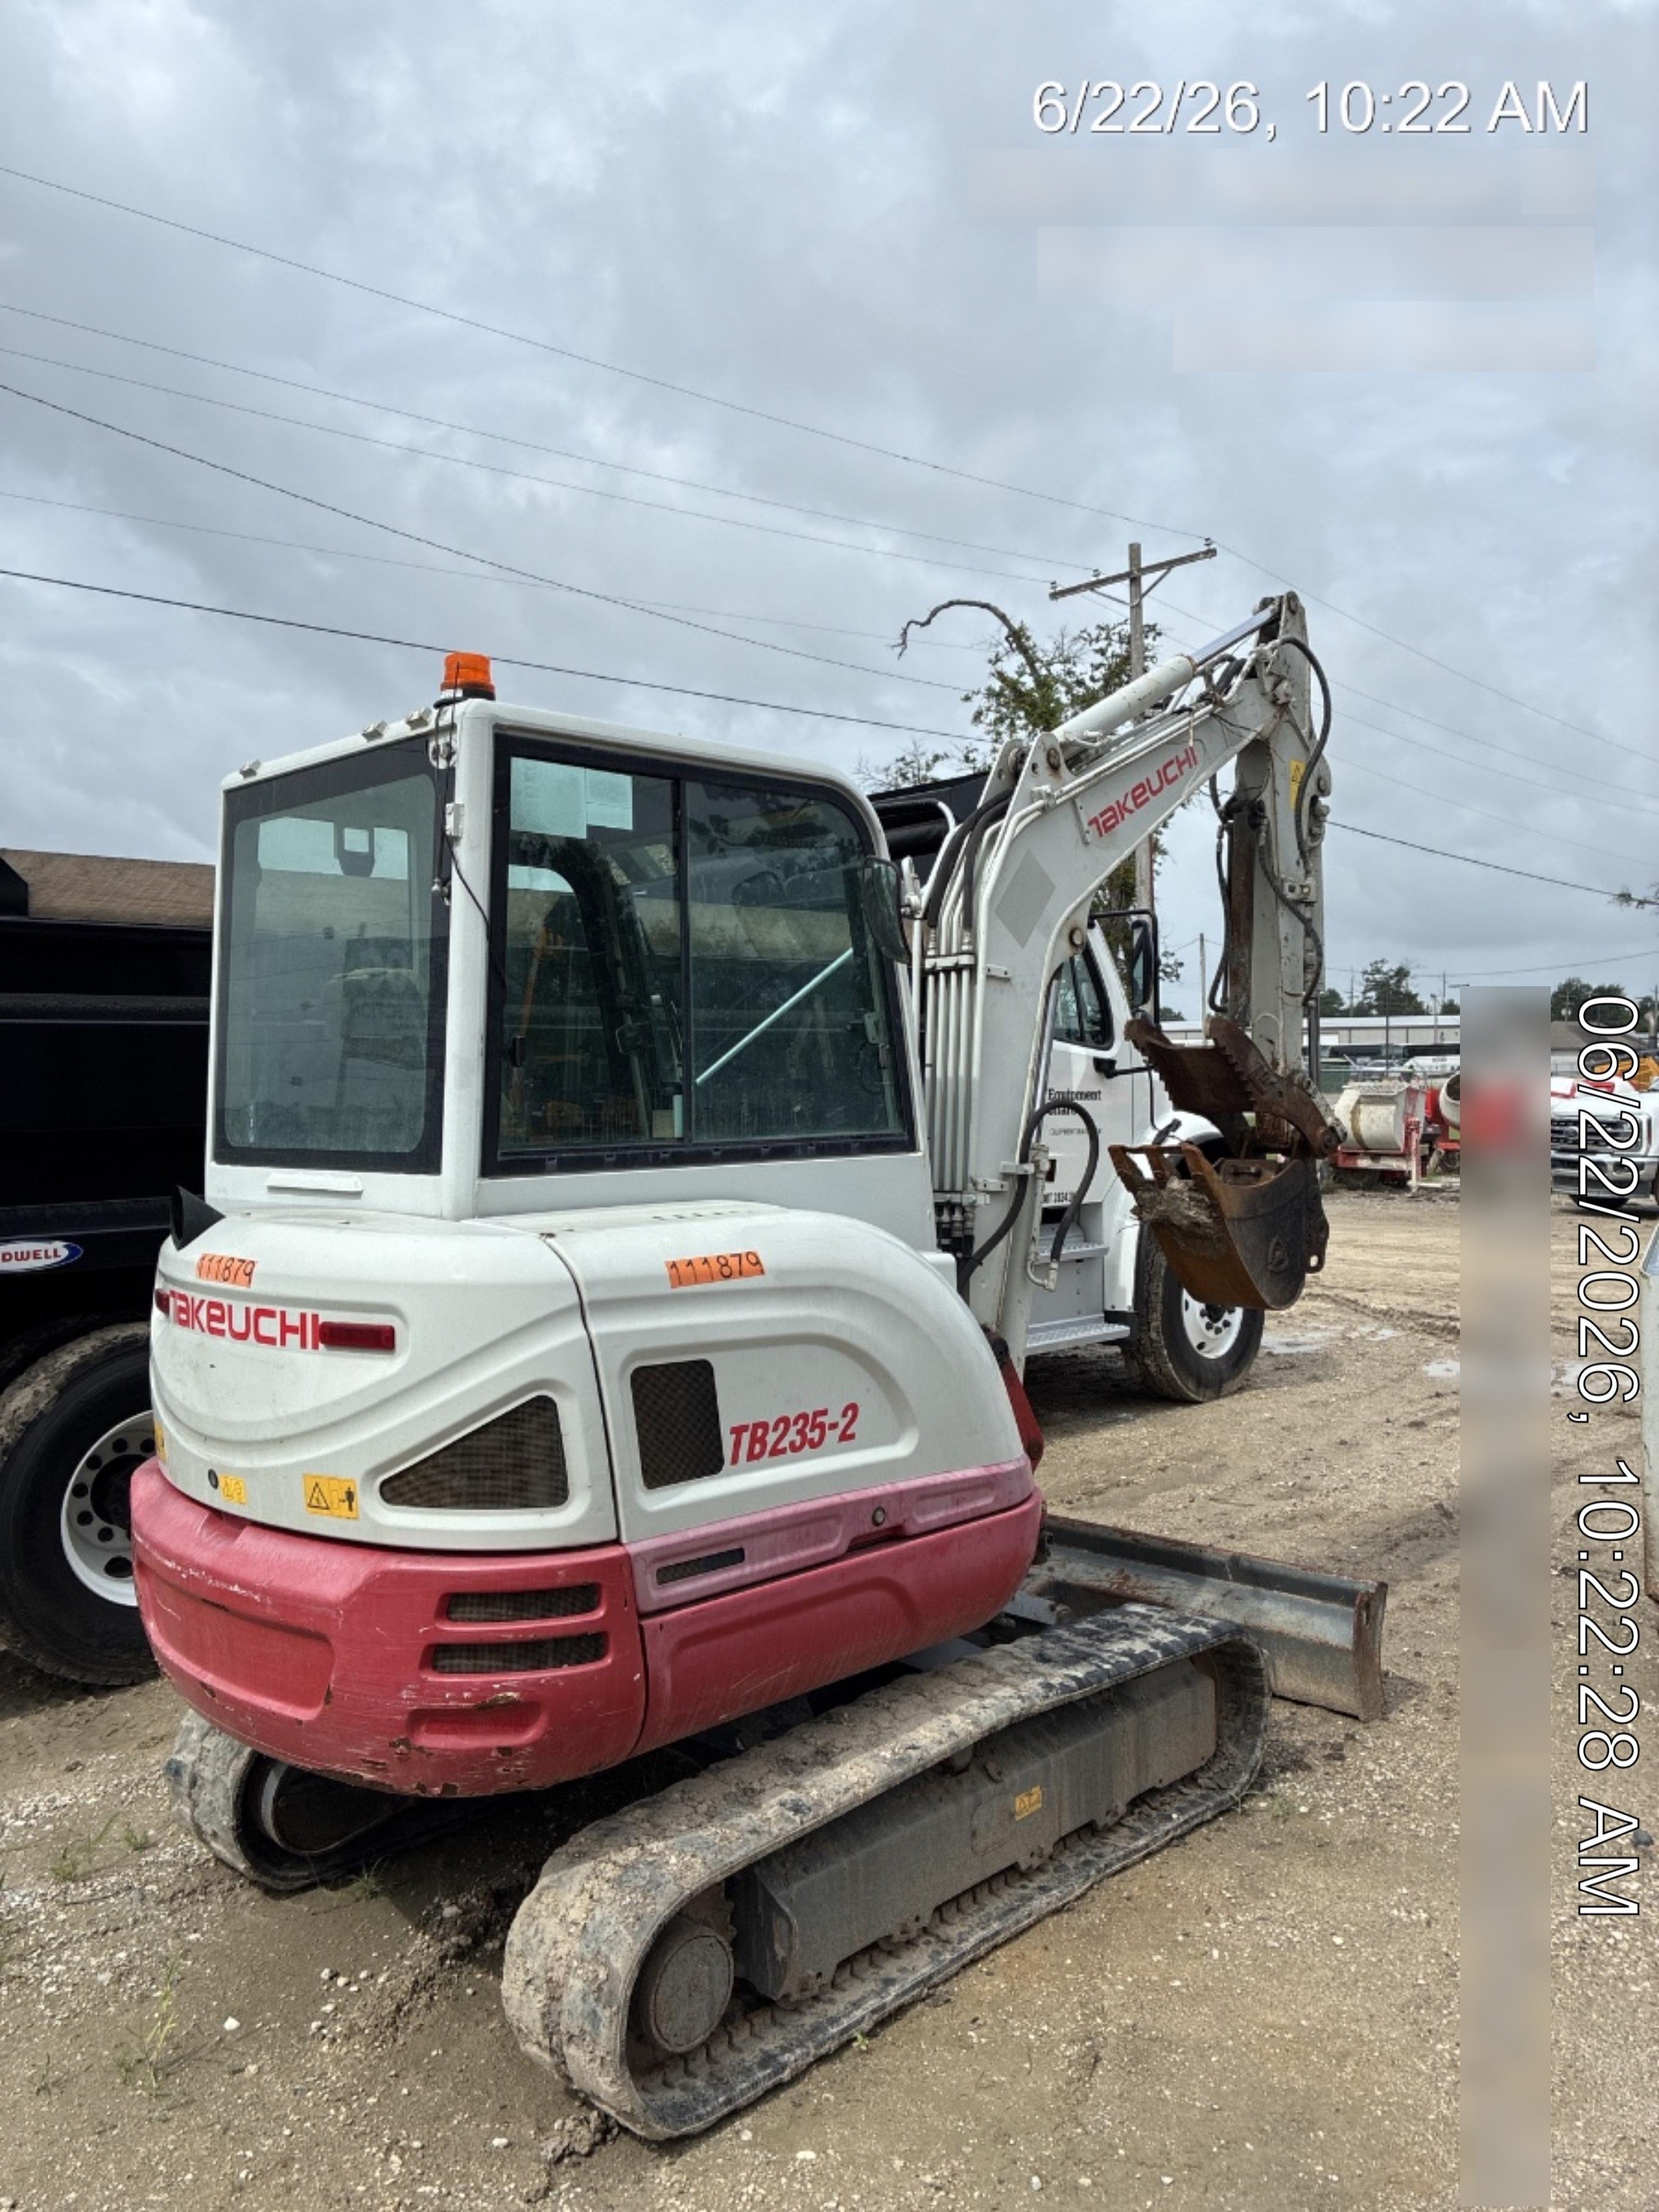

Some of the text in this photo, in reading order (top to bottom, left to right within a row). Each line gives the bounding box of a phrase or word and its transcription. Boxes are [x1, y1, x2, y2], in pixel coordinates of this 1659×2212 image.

[198, 1254, 256, 1288] 111879
[670, 1251, 765, 1285] 111879
[729, 1403, 860, 1466] TB235-2
